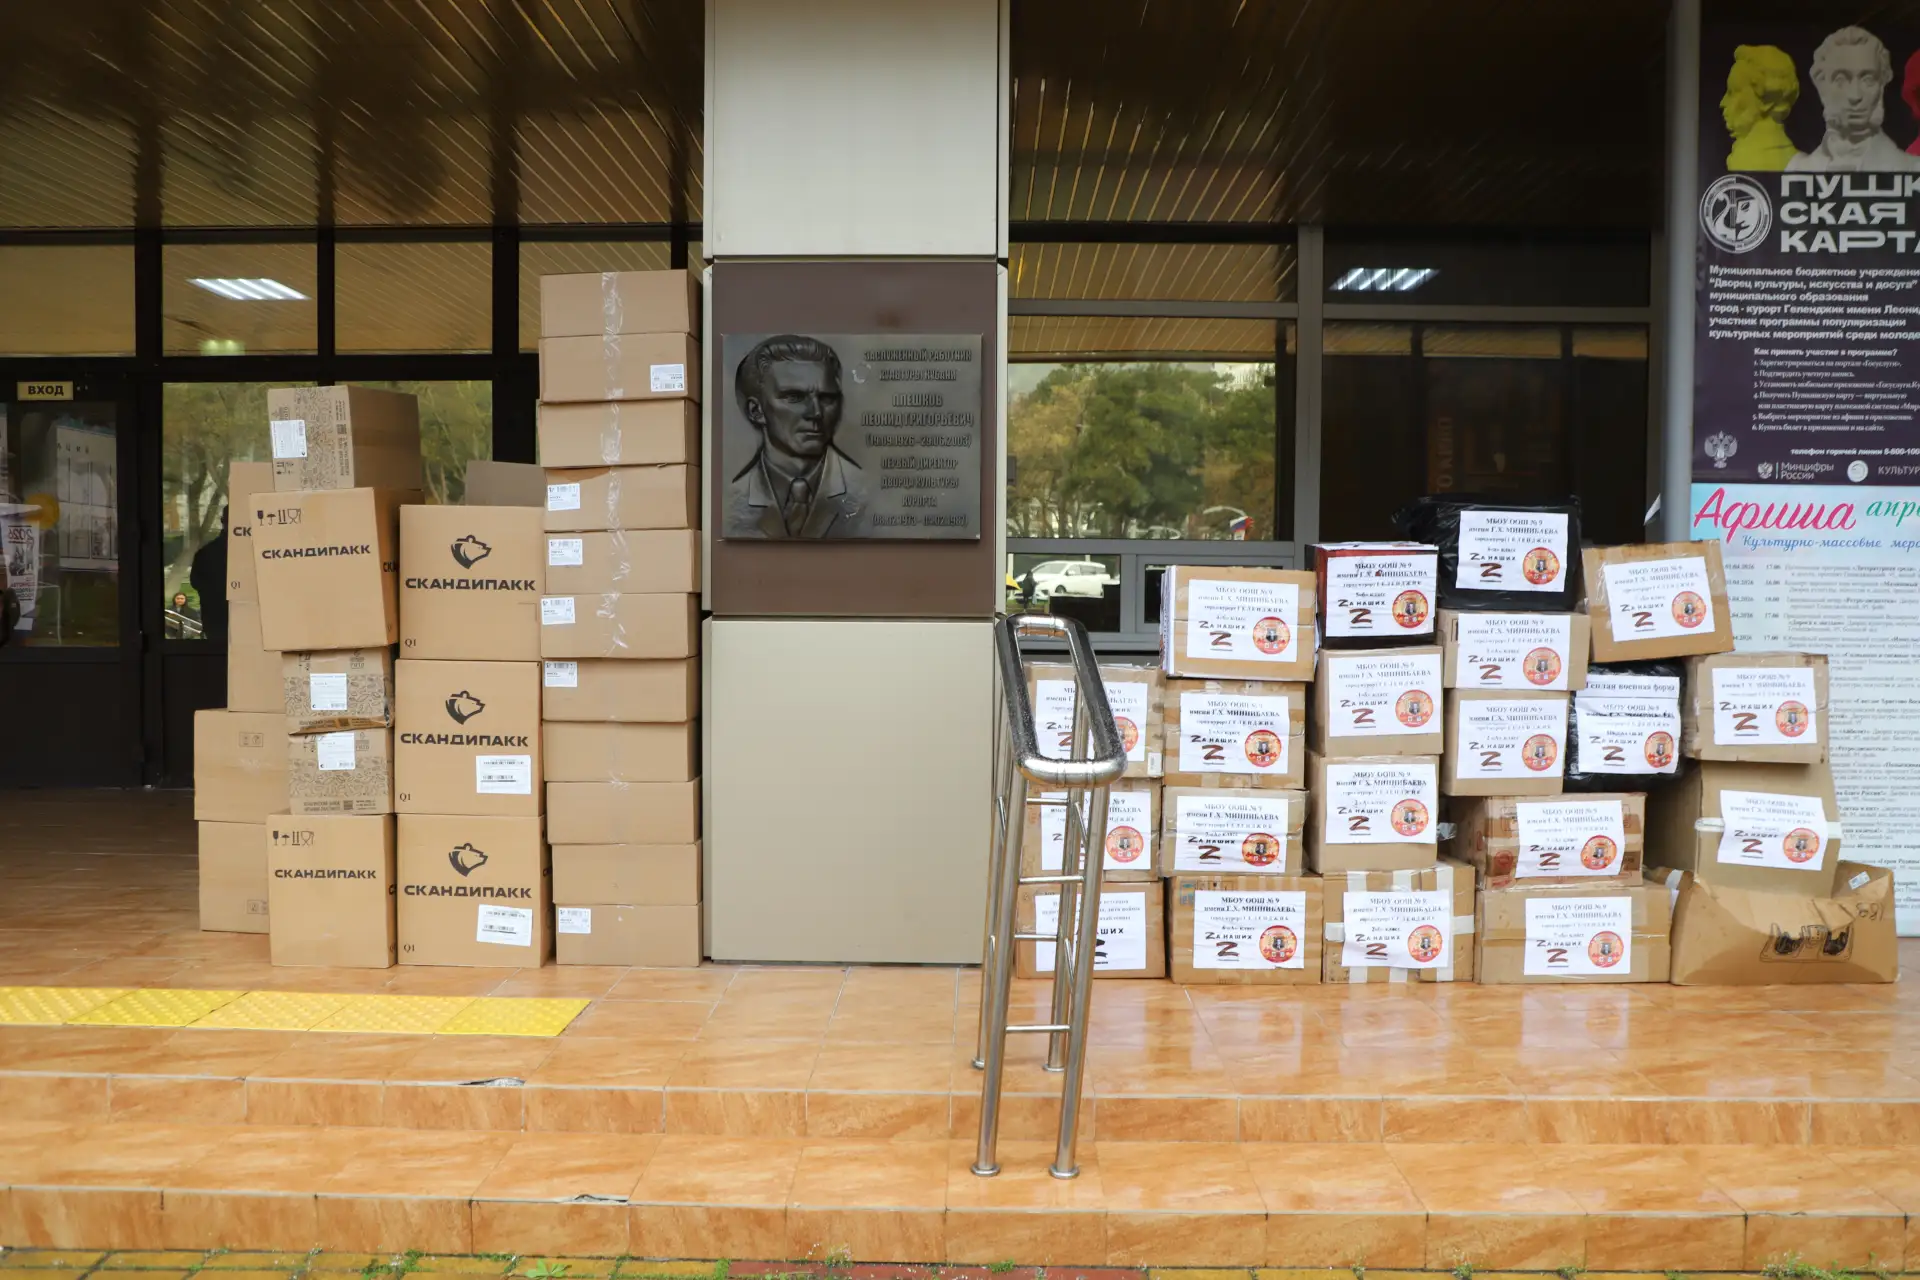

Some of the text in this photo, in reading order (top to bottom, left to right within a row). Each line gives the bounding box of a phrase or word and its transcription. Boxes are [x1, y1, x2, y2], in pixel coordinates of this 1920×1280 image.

[1780, 202, 1905, 225] СКАЯ
[1710, 266, 1793, 276] Муниципальное
[1795, 267, 1856, 277] бюджетное
[1809, 281, 1863, 289] искусства
[1710, 292, 1868, 301] муниципального образования
[1710, 305, 1739, 314] город
[1747, 306, 1781, 315] курорт
[1784, 306, 1844, 315] Геленджик
[1884, 306, 1920, 315] Леони
[1709, 318, 1906, 327] участник программы популяризации
[1709, 330, 1770, 339] культурных
[1773, 329, 1843, 339] мероприятий
[1846, 331, 1877, 340] среди
[864, 348, 972, 361] ЗАСЛУЖЕННЫЙ РАБОТНИК
[1754, 348, 1768, 356] Как
[1771, 349, 1803, 357] принять
[1806, 349, 1838, 357] участие
[1848, 348, 1898, 357] программе?
[880, 370, 957, 381] КУЛЬТУРЫ КУБАНИ
[28, 385, 64, 396] ВХОД
[892, 394, 943, 407] ПЛЕШКОВ
[862, 412, 974, 427] ЛЕОНИД ГРИГОРЬЕВИЧ
[881, 456, 958, 470] ПЕРВЫЙ ДИРЕКТОР
[1781, 462, 1834, 472] Минцифры
[1781, 472, 1815, 480] России
[881, 477, 959, 489] ДВОРЦА КУЛЬТУРЫ
[902, 496, 937, 507] КУРОРТА
[1694, 487, 1857, 544] Афиша
[1742, 535, 1882, 553] Культурно-массовые
[262, 545, 370, 559] СКАНДИПАКК
[231, 581, 241, 589] Q1
[405, 578, 536, 590] СКАНДИПАКК
[405, 639, 416, 647] Q1
[400, 733, 528, 747] СКАНДИПАКК
[400, 793, 411, 801] Q1
[275, 869, 377, 879] СКАНДИПАКК
[404, 885, 532, 898] СКАНДИПАКК
